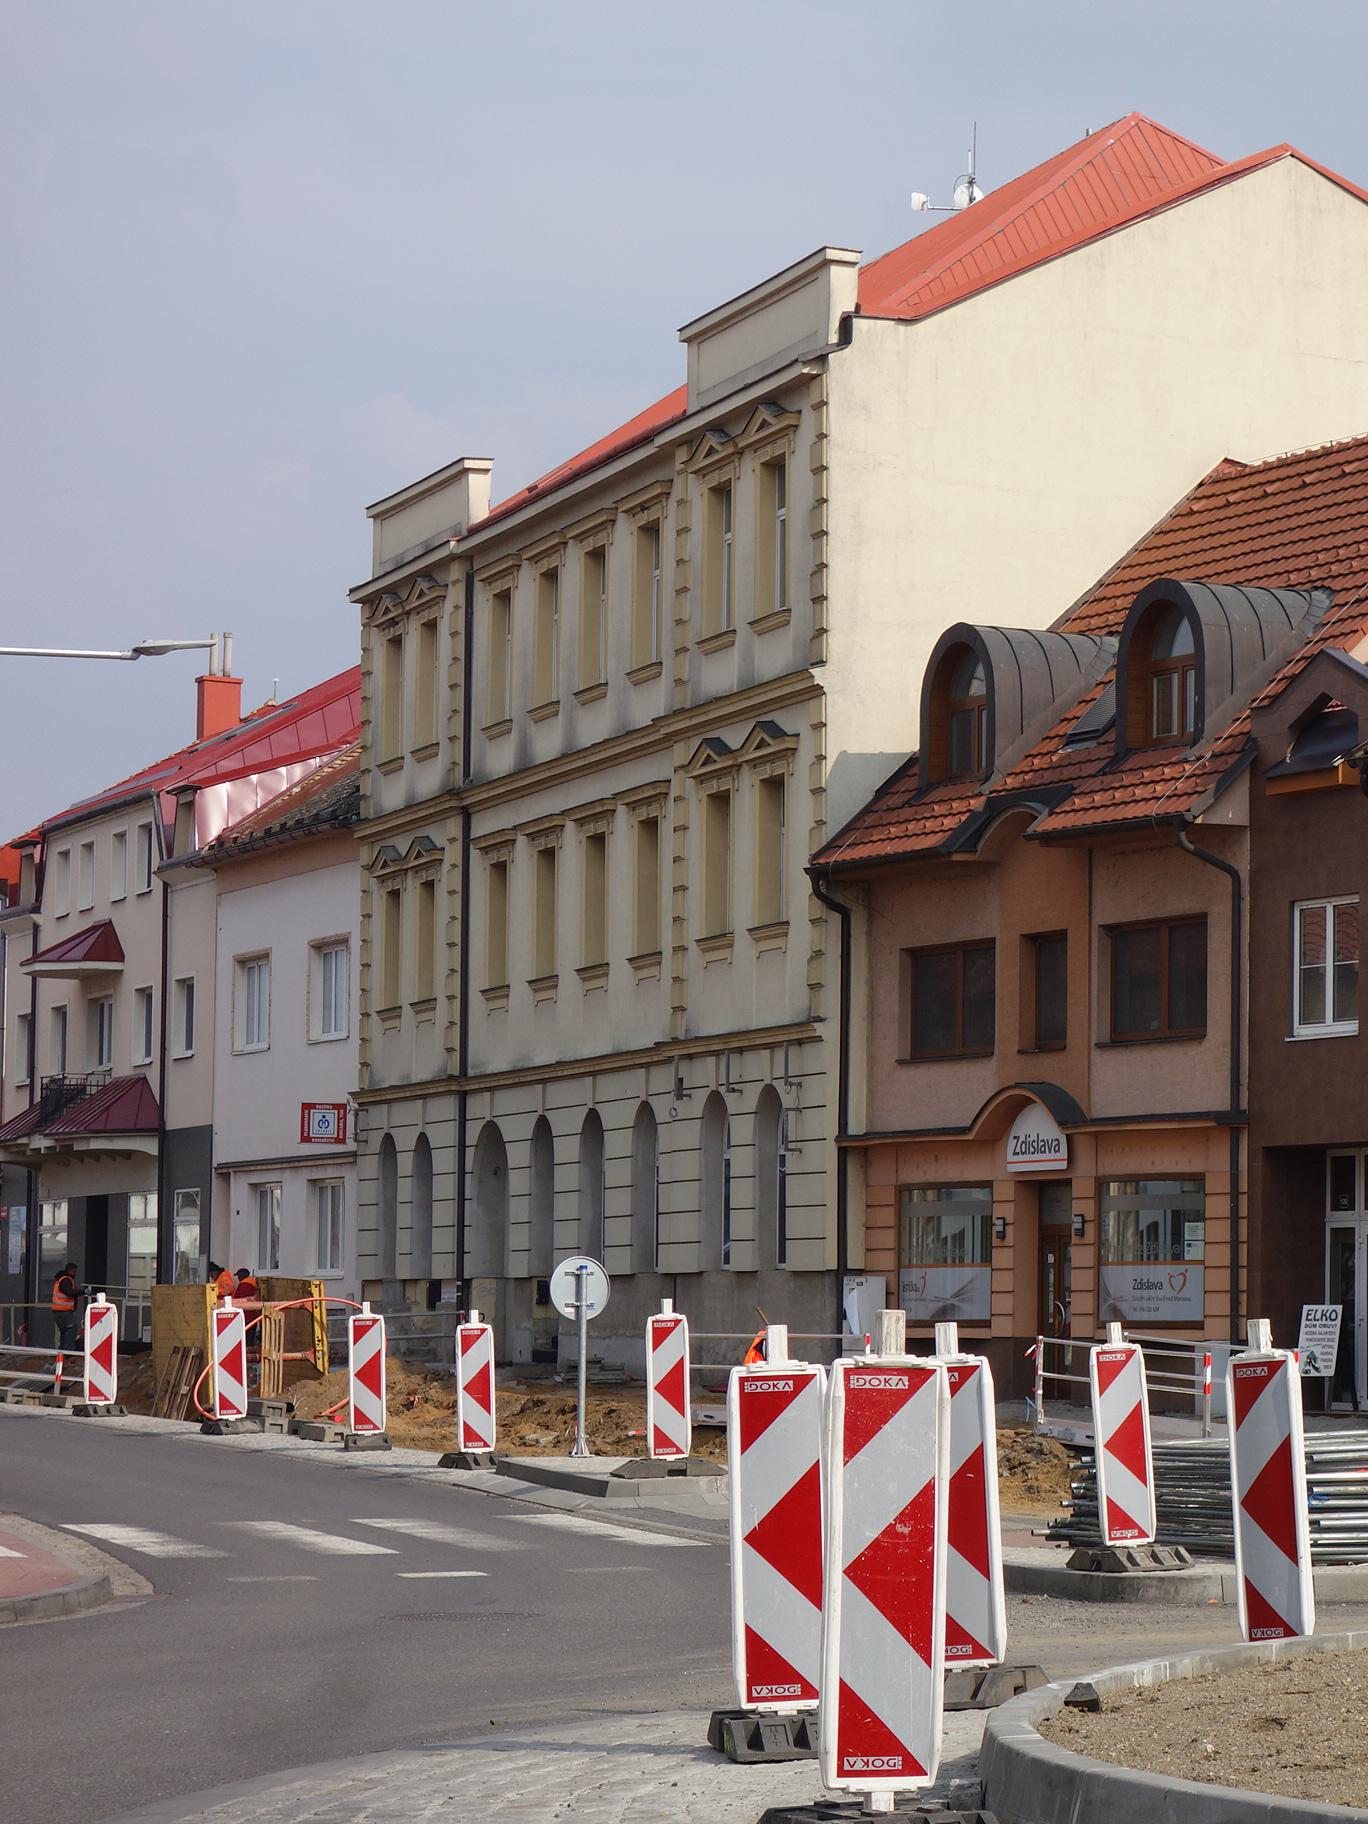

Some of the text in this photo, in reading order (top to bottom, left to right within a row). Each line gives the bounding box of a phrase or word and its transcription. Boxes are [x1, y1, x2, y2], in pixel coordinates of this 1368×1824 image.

[1012, 1133, 1061, 1156] Zdislava
[1132, 1278, 1164, 1291] Zdislava
[1305, 1308, 1338, 1322] ELKO
[1238, 1367, 1266, 1376] DOKA
[749, 1381, 793, 1391] DOKA
[856, 1377, 907, 1388] DOKA
